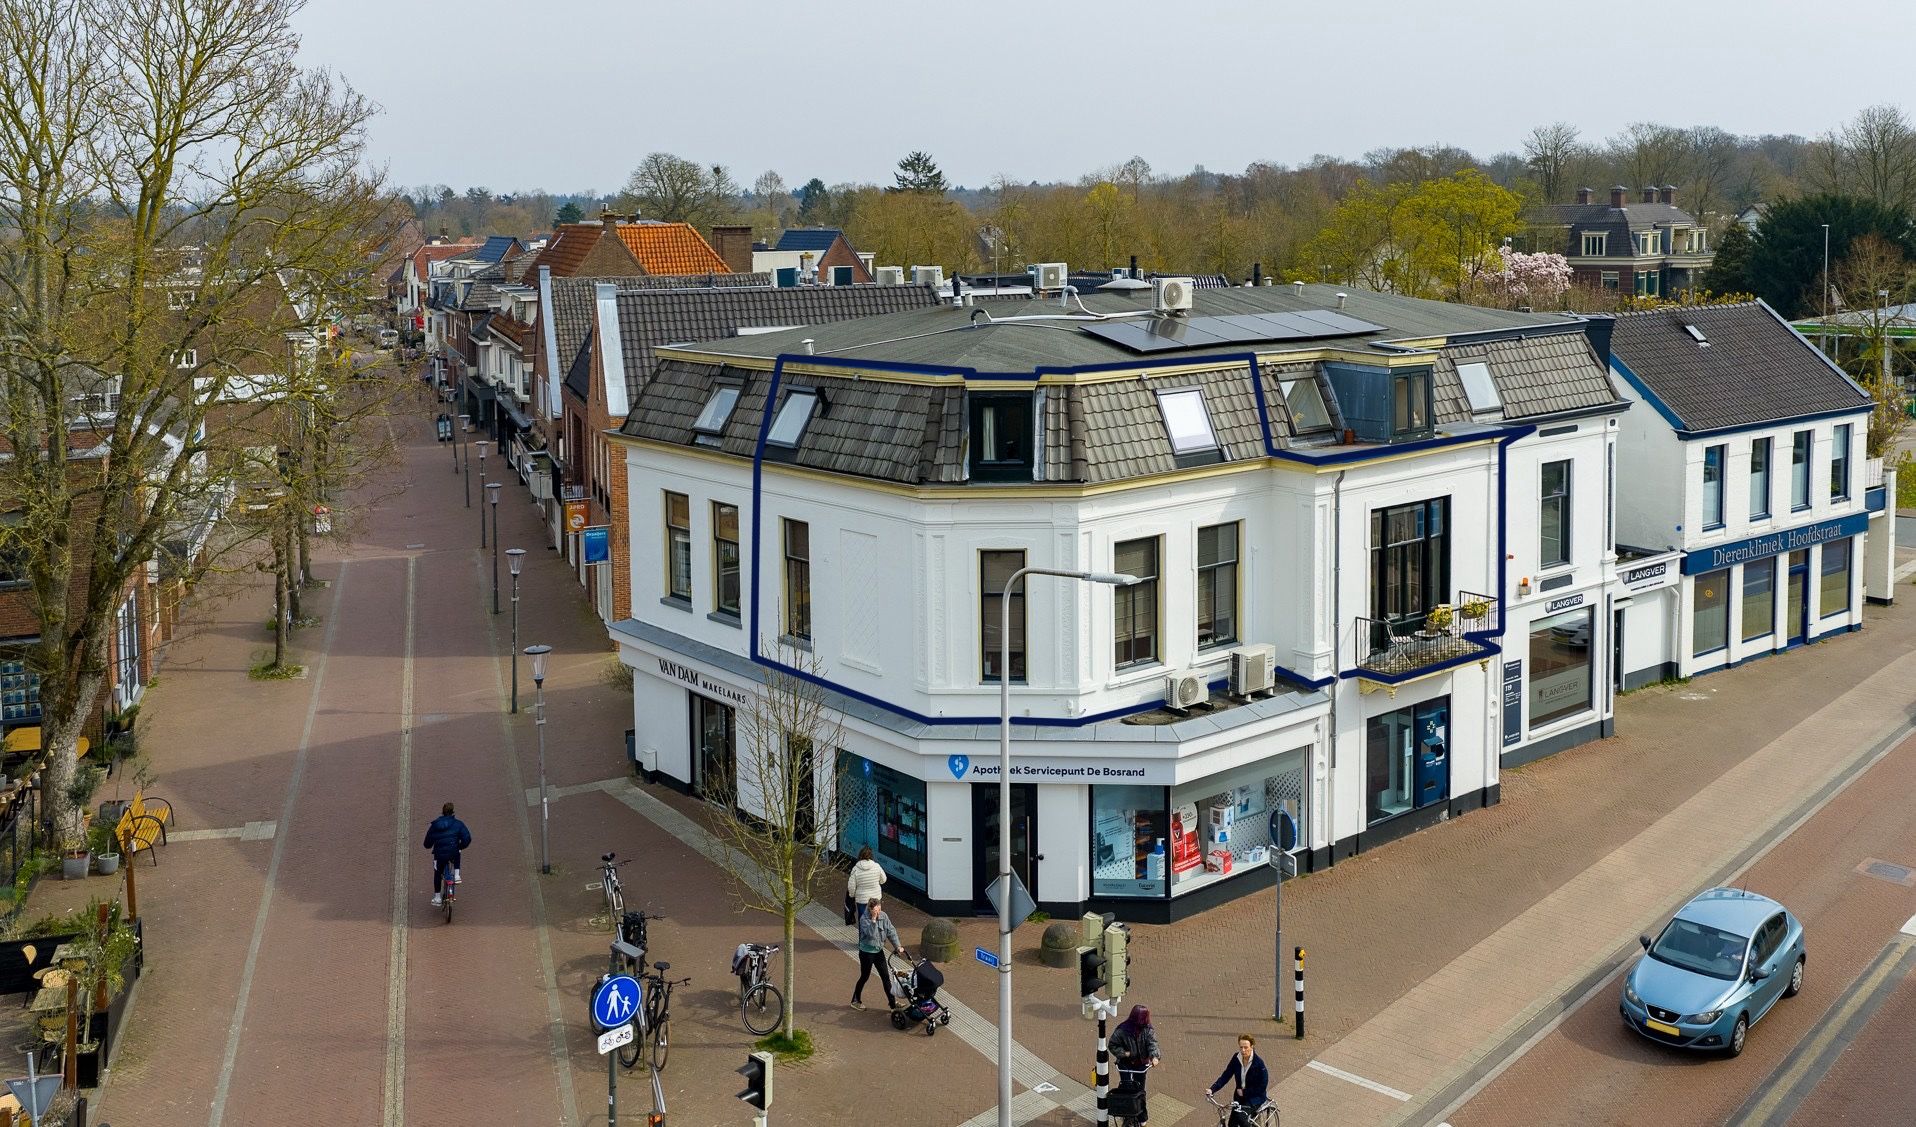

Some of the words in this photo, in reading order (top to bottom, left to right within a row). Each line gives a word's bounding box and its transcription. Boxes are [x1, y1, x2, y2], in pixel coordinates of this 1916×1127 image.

[1712, 534, 1784, 566] Dierenkliniek
[1787, 523, 1842, 549] Hoofdstraat
[1630, 565, 1665, 581] LANGVER
[1552, 595, 1583, 610] LANGVER
[658, 658, 676, 677] VAN
[678, 666, 699, 686] DAM
[702, 680, 746, 704] MAKELAARS
[972, 765, 1022, 775] Apothek
[1024, 766, 1085, 778] Servicepunt
[1087, 767, 1101, 776] De
[1103, 767, 1145, 777] Bosrand
